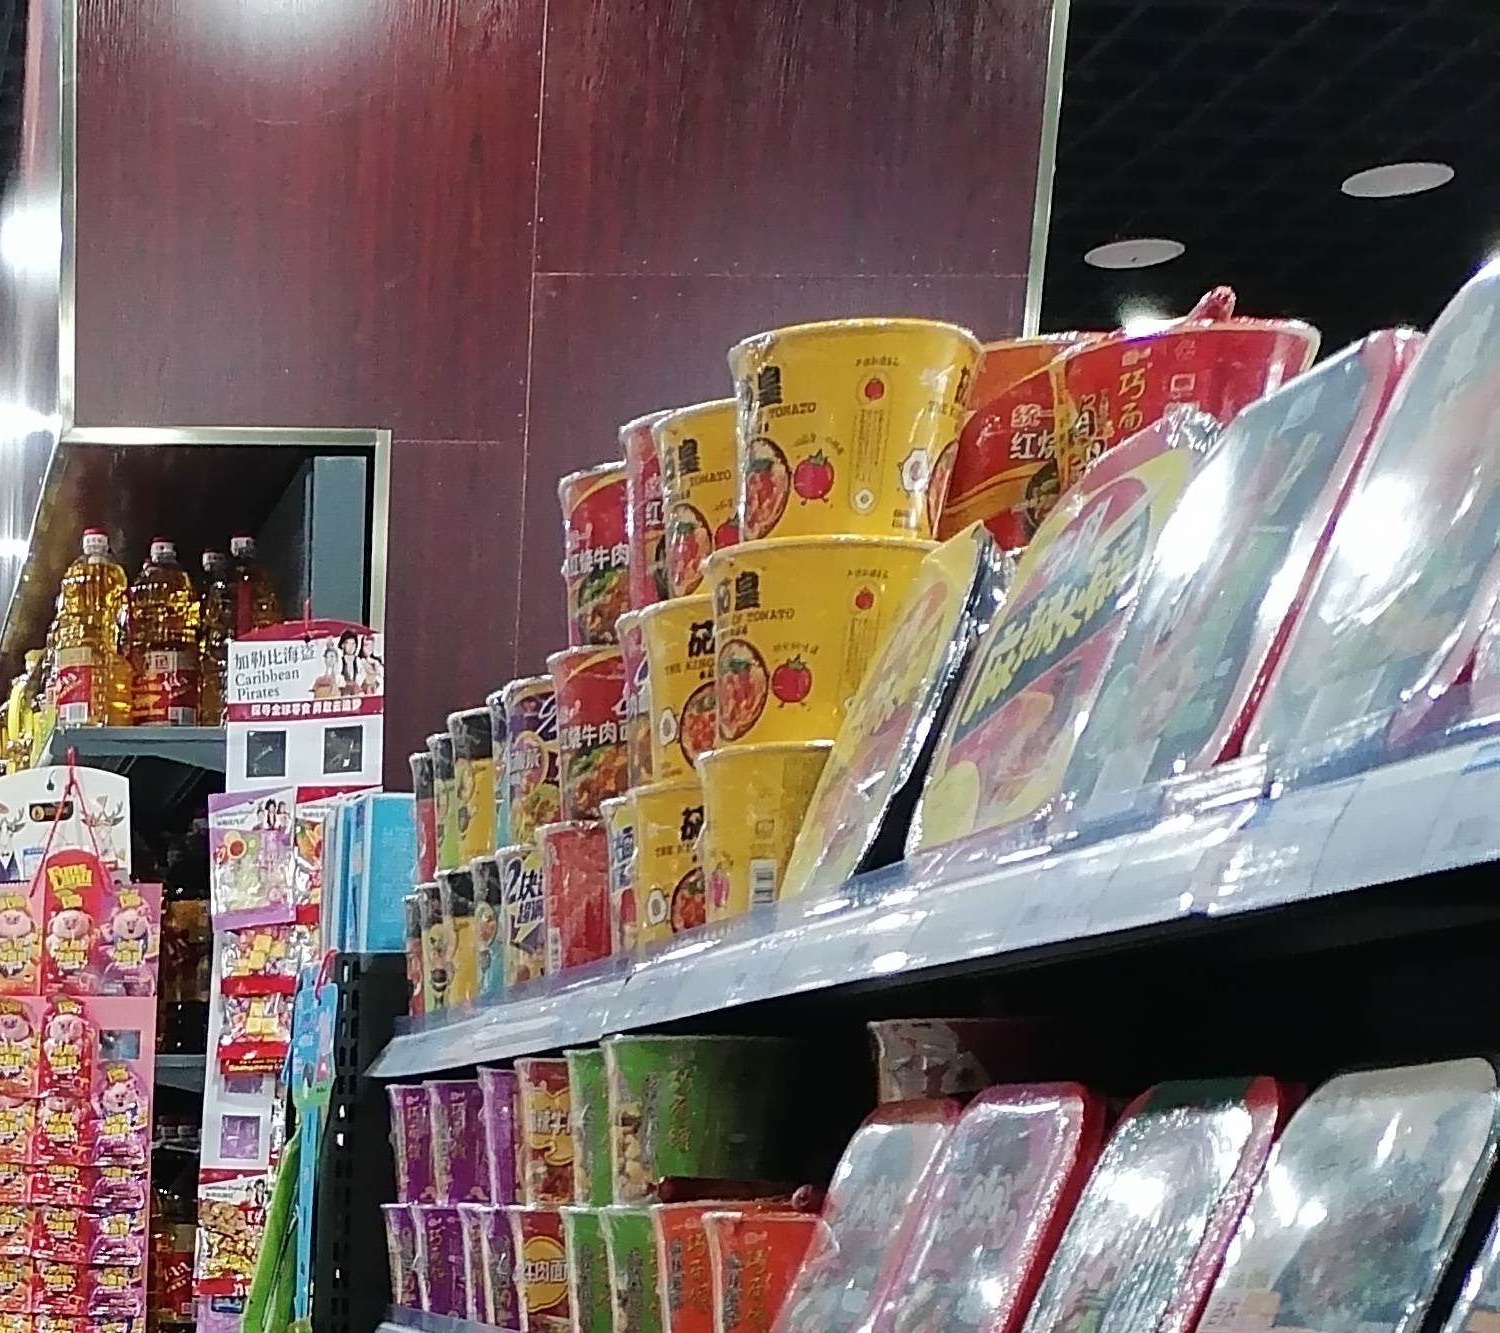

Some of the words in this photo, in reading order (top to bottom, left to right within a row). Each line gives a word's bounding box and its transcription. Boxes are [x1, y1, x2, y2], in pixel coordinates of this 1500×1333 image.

[768, 402, 817, 419] TOMATO
[747, 607, 795, 624] TOMATO
[233, 645, 317, 671] 加勒比海盗
[234, 668, 301, 687] Caribbean
[236, 686, 280, 702] Pirates
